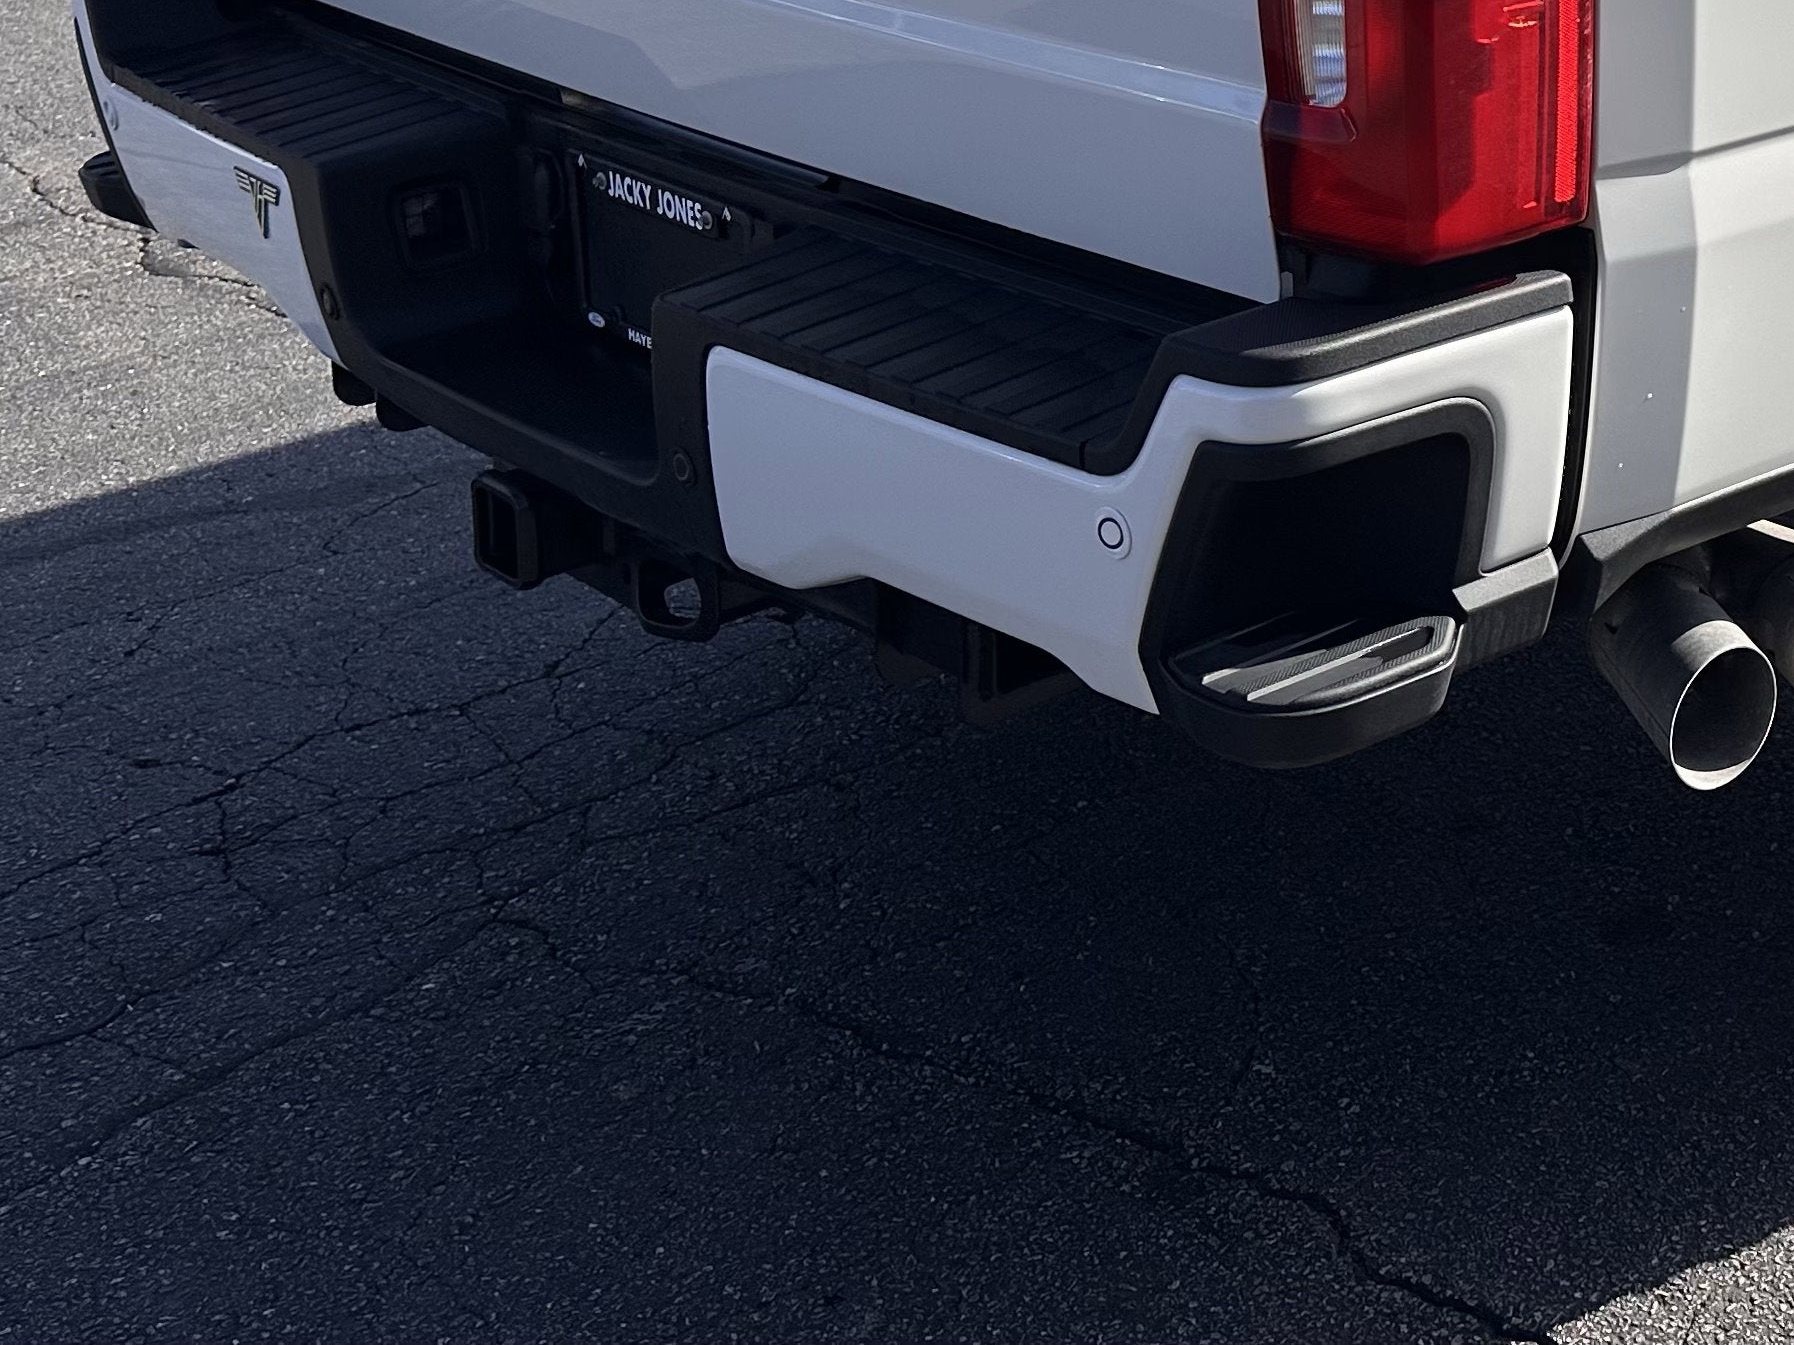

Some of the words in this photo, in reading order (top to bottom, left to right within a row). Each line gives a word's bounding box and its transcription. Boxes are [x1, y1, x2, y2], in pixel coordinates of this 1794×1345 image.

[608, 170, 652, 210] JACKY
[656, 188, 704, 231] JONES
[627, 327, 653, 350] HAYE
